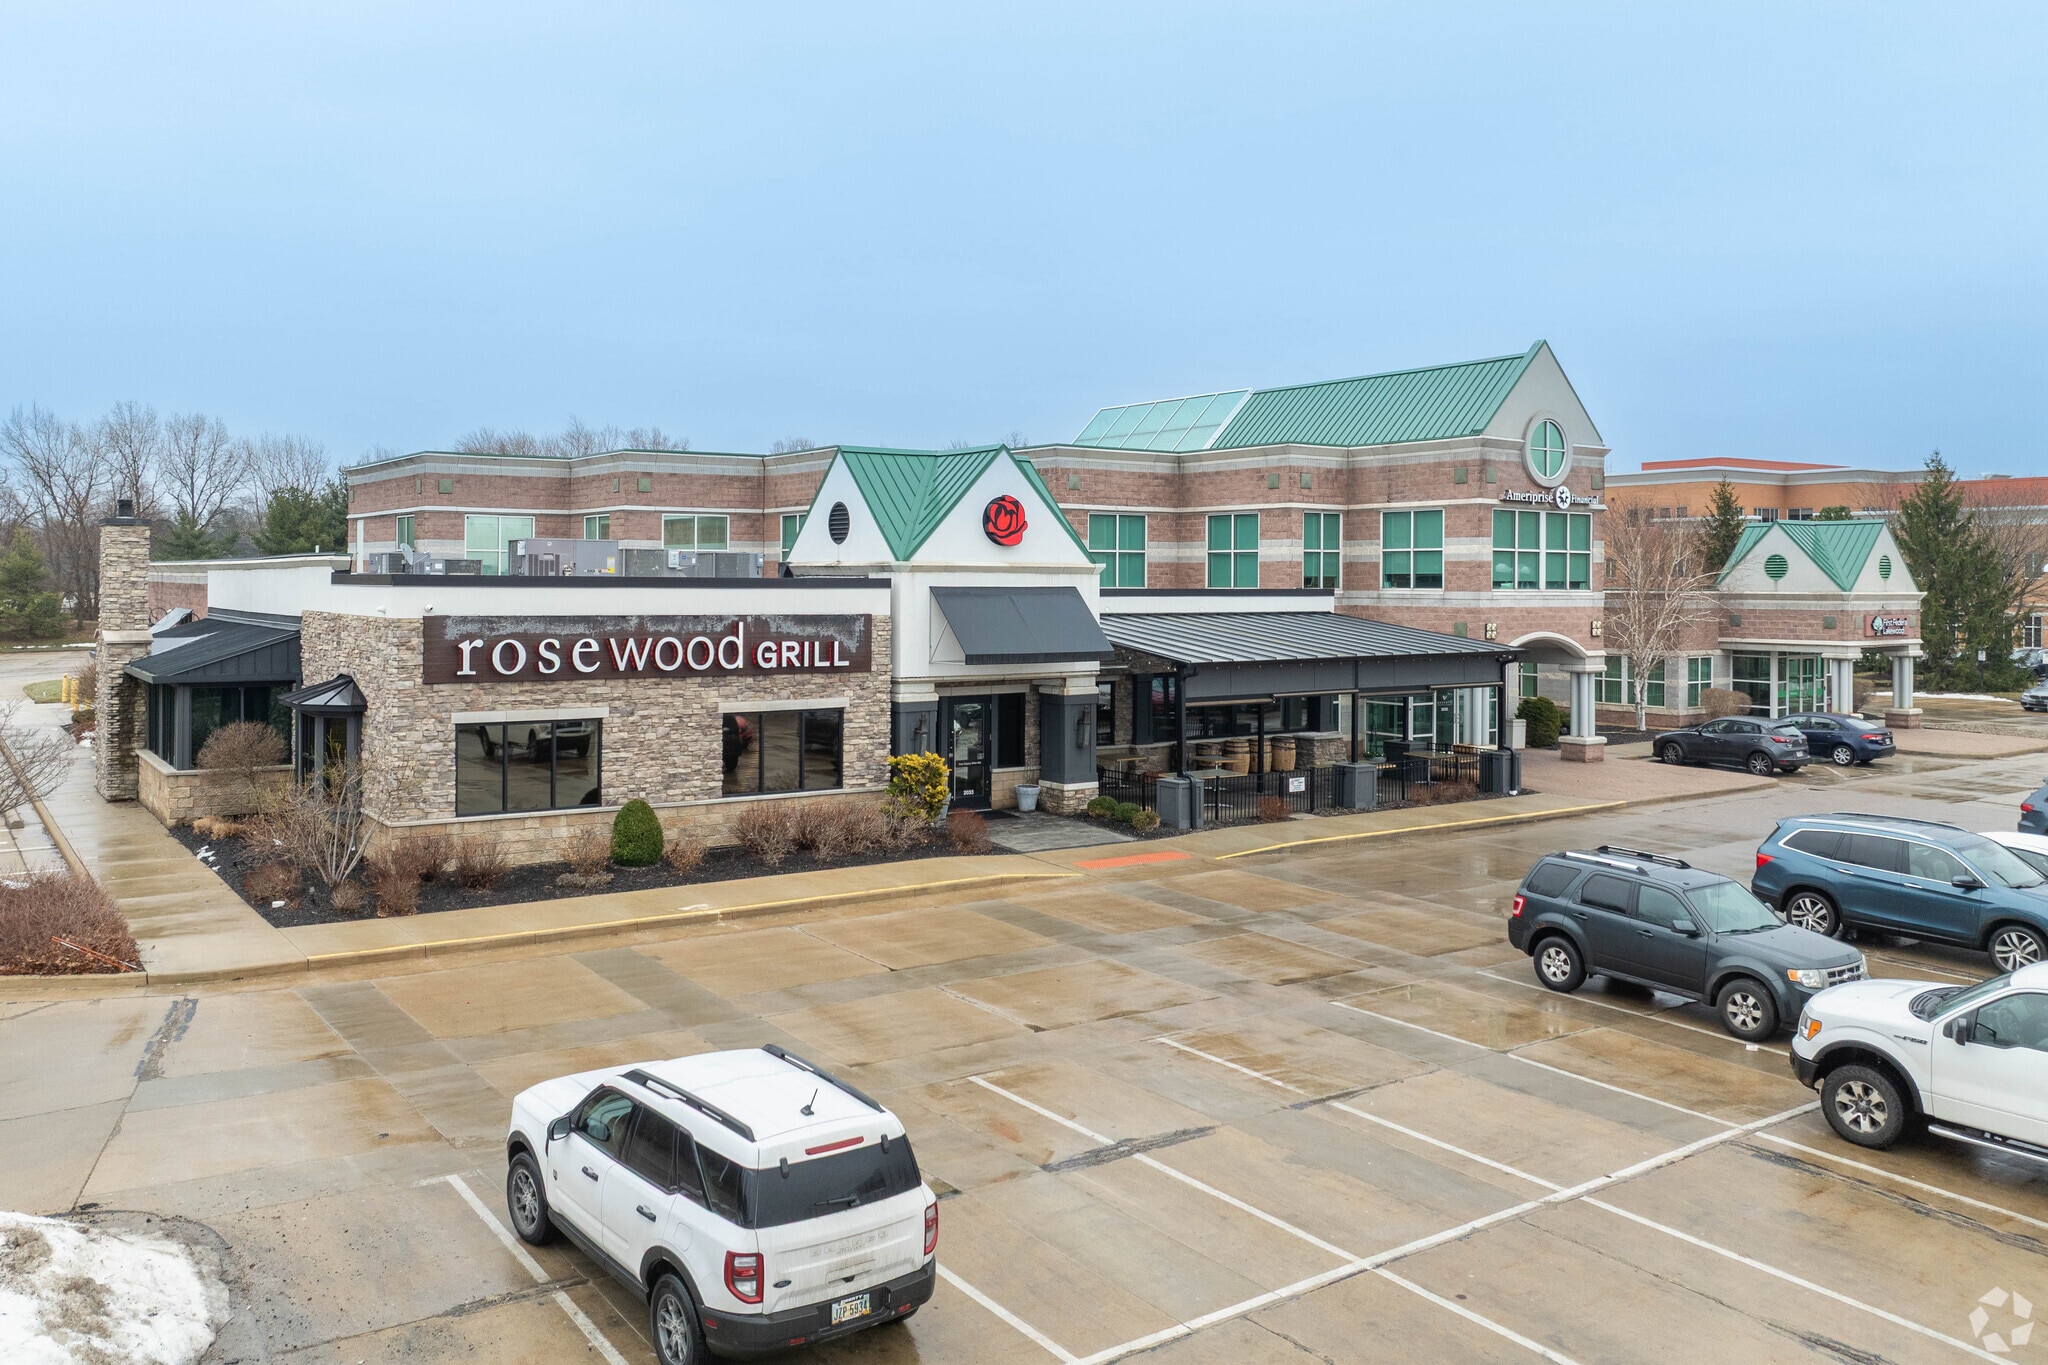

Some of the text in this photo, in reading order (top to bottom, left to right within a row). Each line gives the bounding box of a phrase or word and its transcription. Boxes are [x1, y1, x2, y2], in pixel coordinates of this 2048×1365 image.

[1507, 489, 1599, 506] Ameriprise Financial
[456, 621, 850, 676] rosewood GRILL
[833, 1299, 868, 1321] JZP 5934
